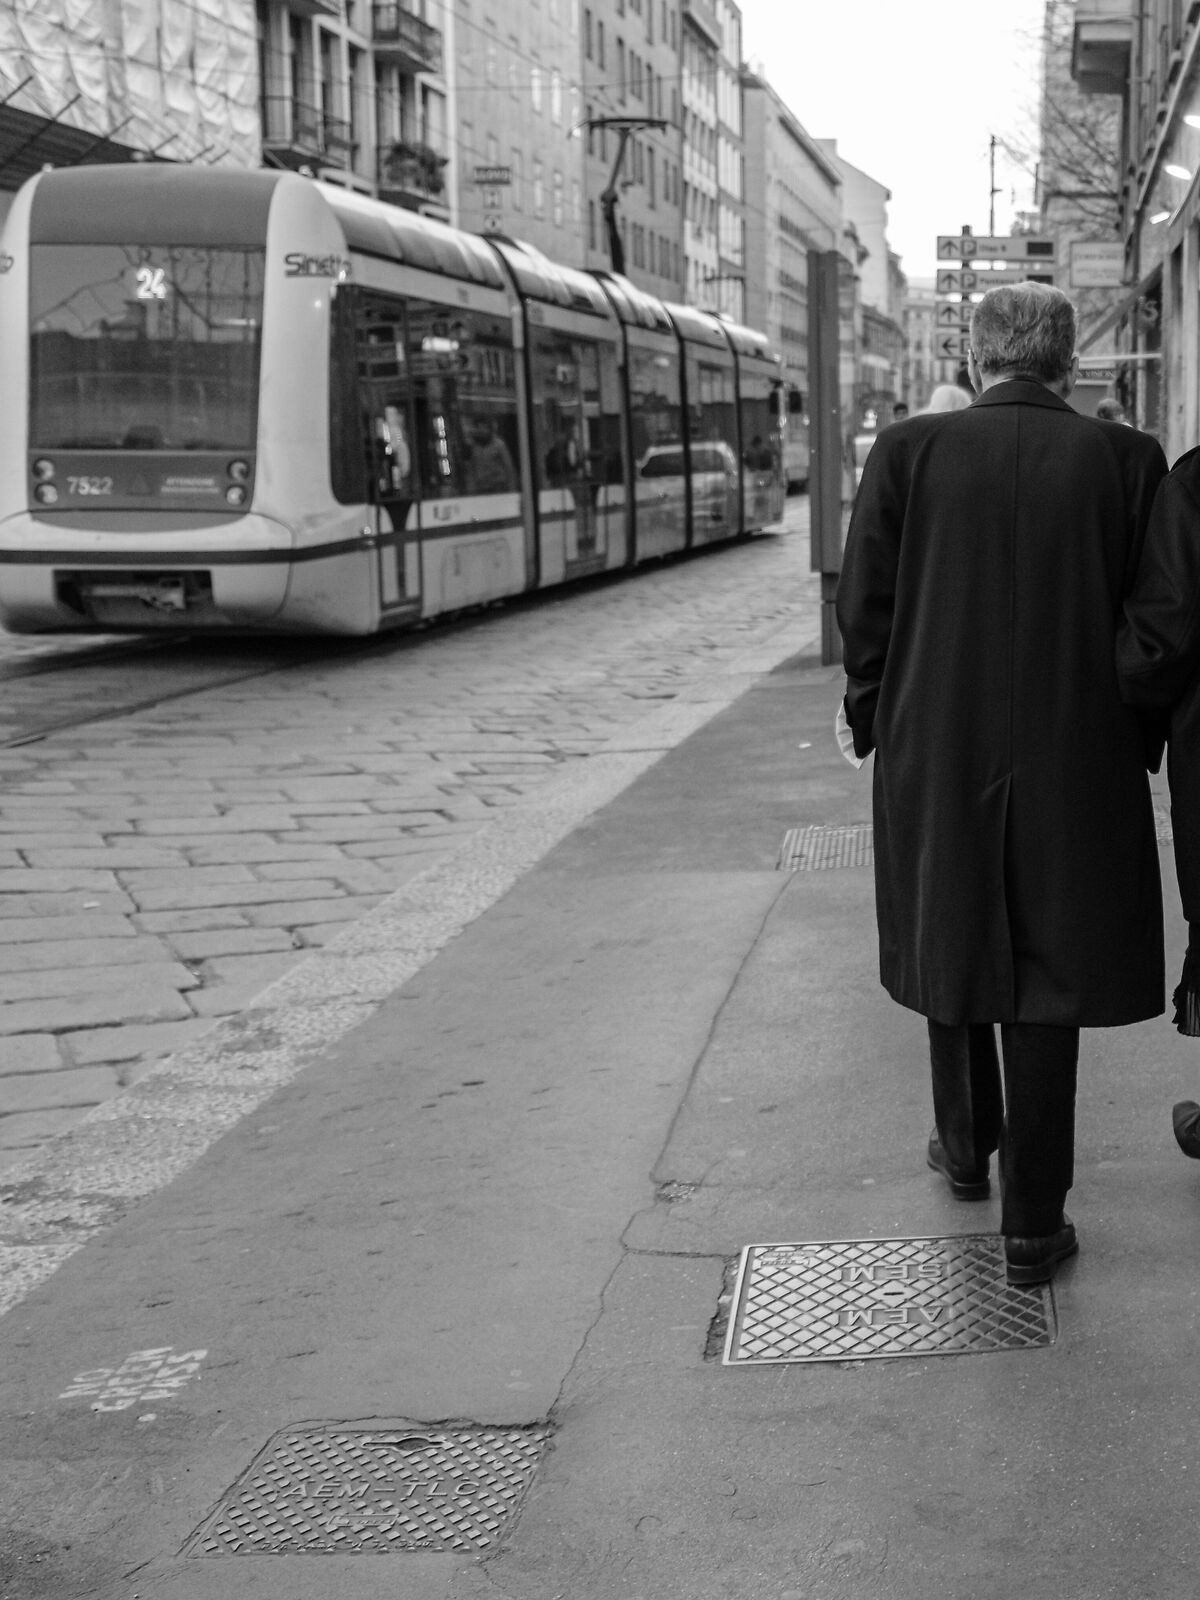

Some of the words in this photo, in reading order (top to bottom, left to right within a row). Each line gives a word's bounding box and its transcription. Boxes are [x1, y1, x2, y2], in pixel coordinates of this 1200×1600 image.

[136, 268, 166, 299] 24
[67, 476, 113, 495] 7522
[850, 1264, 943, 1281] SEM
[847, 1307, 943, 1325] AEM
[138, 1349, 209, 1401] PASS
